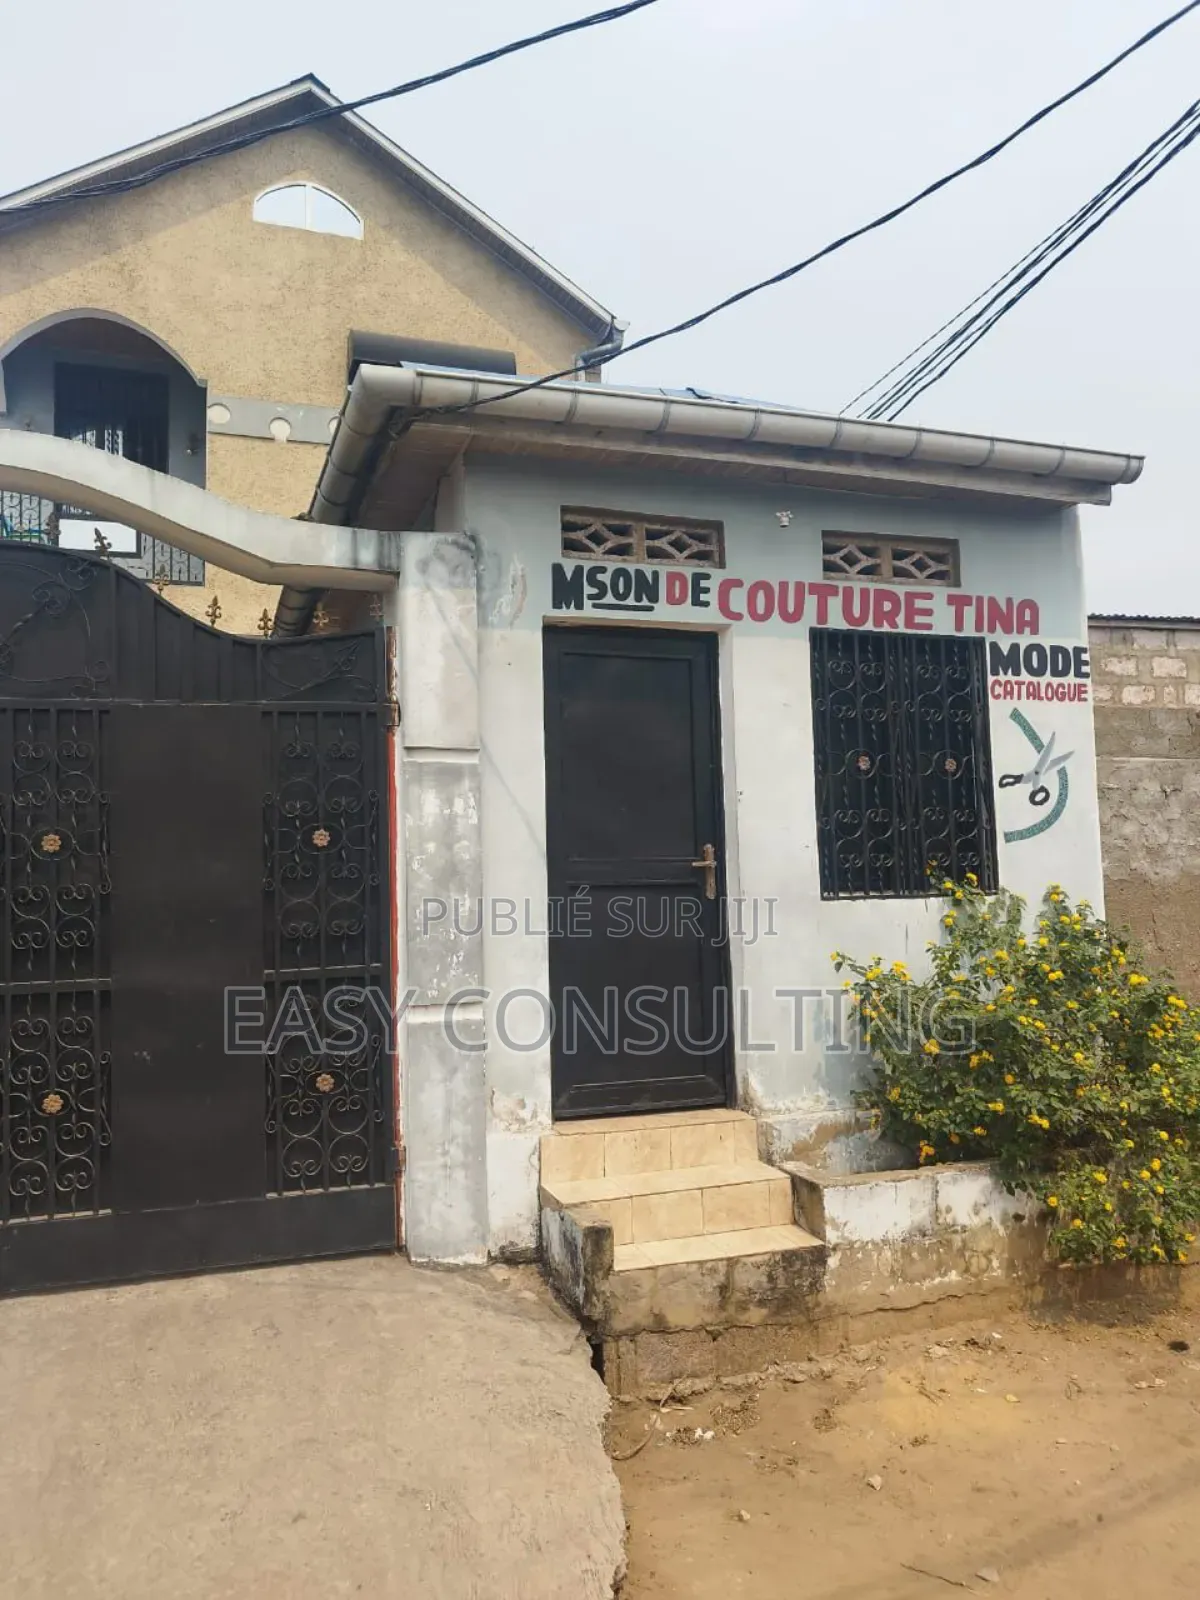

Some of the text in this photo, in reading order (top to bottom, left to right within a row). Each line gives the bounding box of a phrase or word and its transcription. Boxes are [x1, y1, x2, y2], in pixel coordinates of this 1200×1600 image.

[551, 563, 1040, 635] MSON DE COUTURE TINA
[989, 641, 1091, 679] MODE
[989, 679, 1088, 702] CATALOGUE
